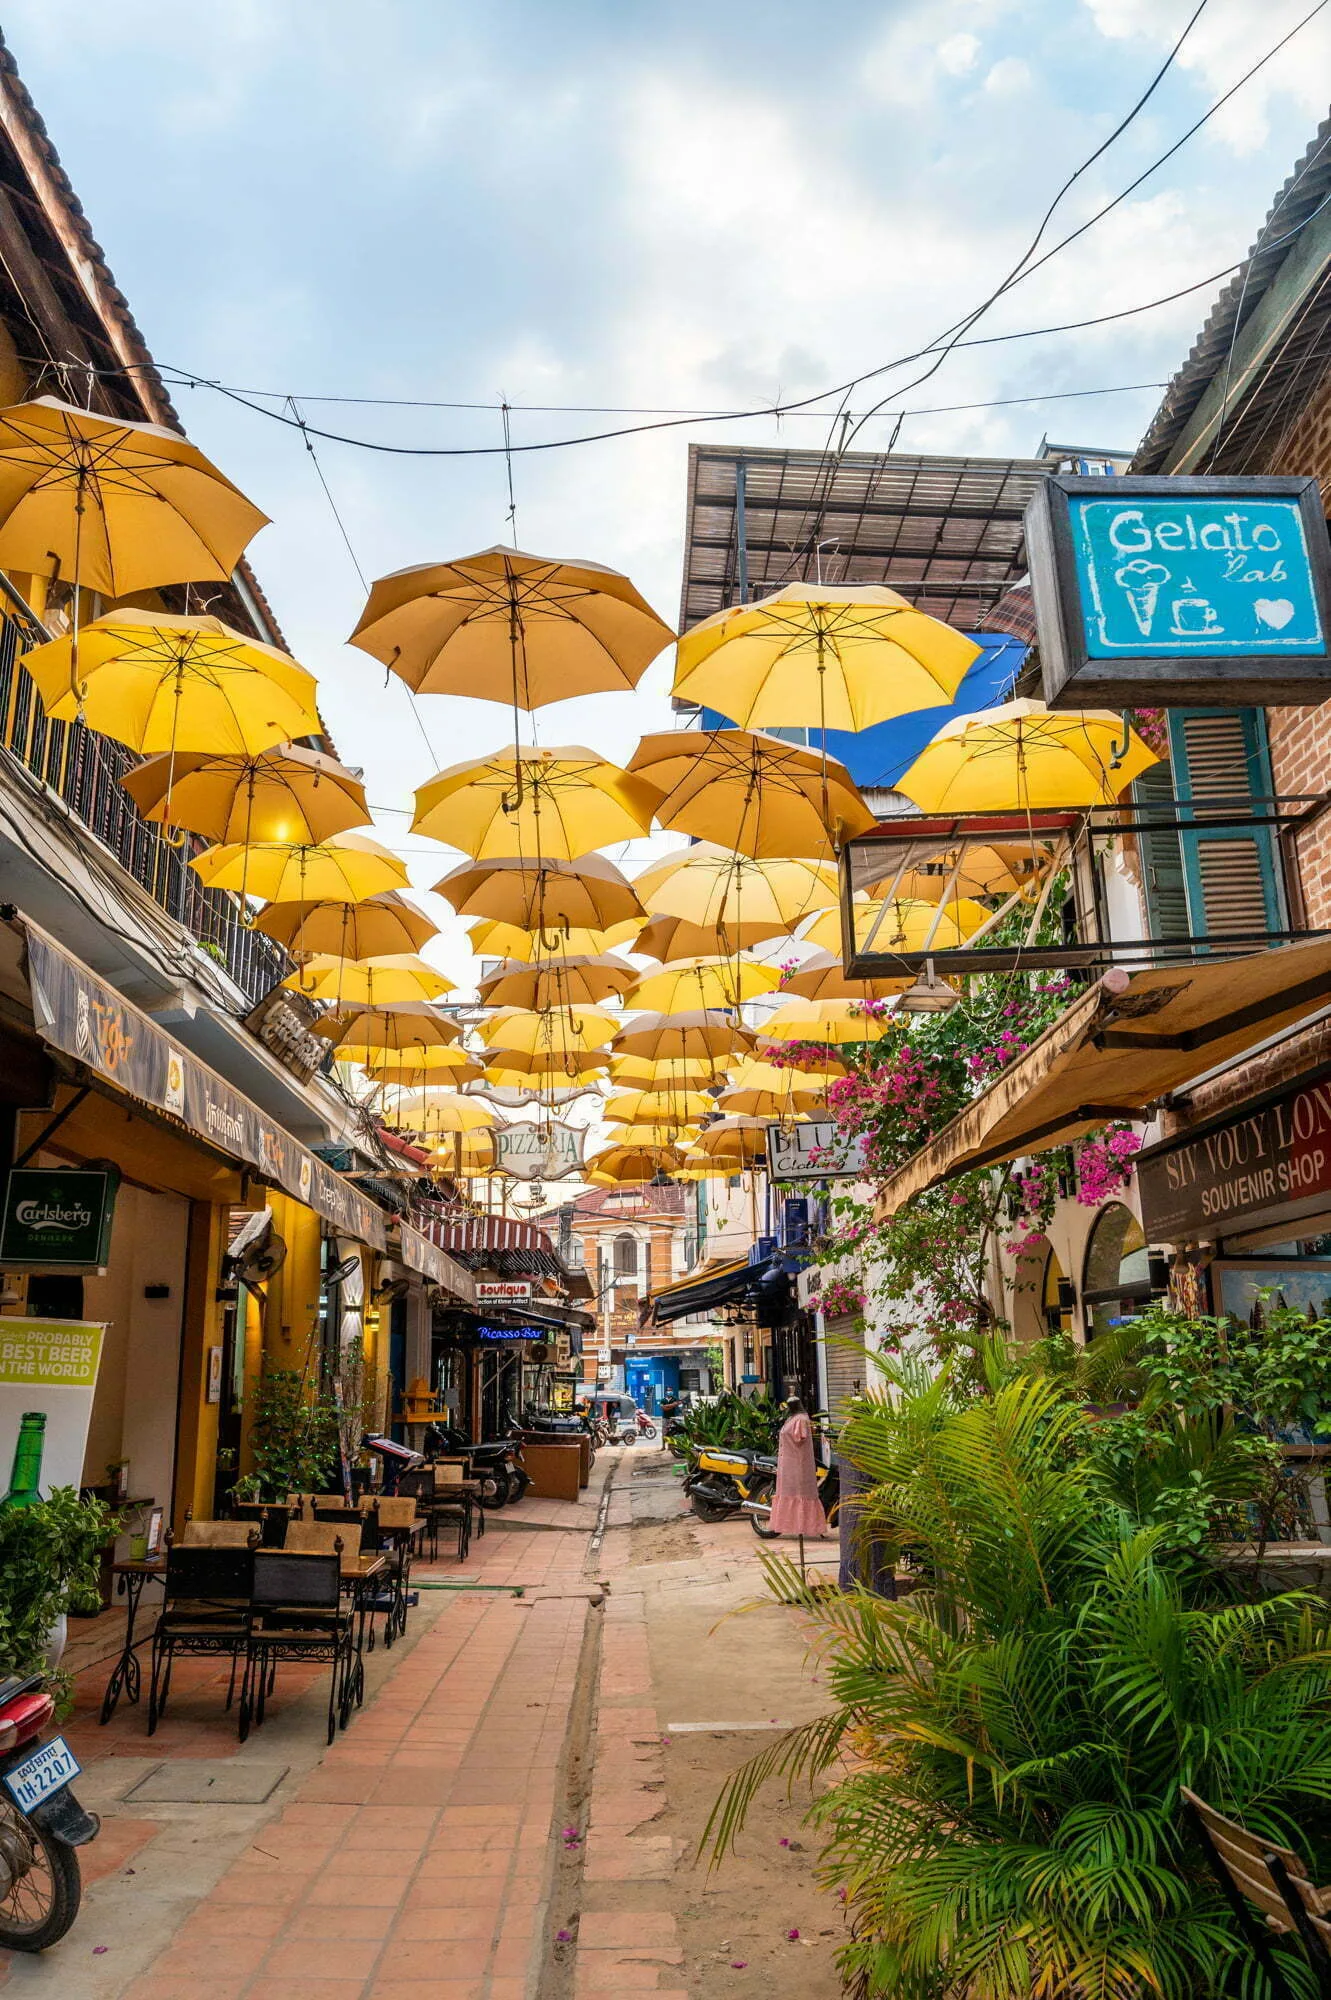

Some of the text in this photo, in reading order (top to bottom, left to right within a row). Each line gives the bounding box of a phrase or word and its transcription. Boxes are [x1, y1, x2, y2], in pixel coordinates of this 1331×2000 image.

[1109, 510, 1282, 553] Gelato
[496, 1133, 578, 1165] PIZZERIA
[1166, 1144, 1198, 1192] SIV
[1204, 1114, 1268, 1174] VOUY
[1202, 1149, 1325, 1216] SOUVENIR SHOP
[15, 1200, 92, 1230] Carlsberg
[480, 1284, 527, 1296] Boutique
[26, 1332, 94, 1346] PROBABLY
[478, 1325, 543, 1339] Picasso Bar
[2, 1343, 93, 1363] BEST BEER
[8, 1361, 36, 1376] THE
[38, 1363, 90, 1378] WORLD
